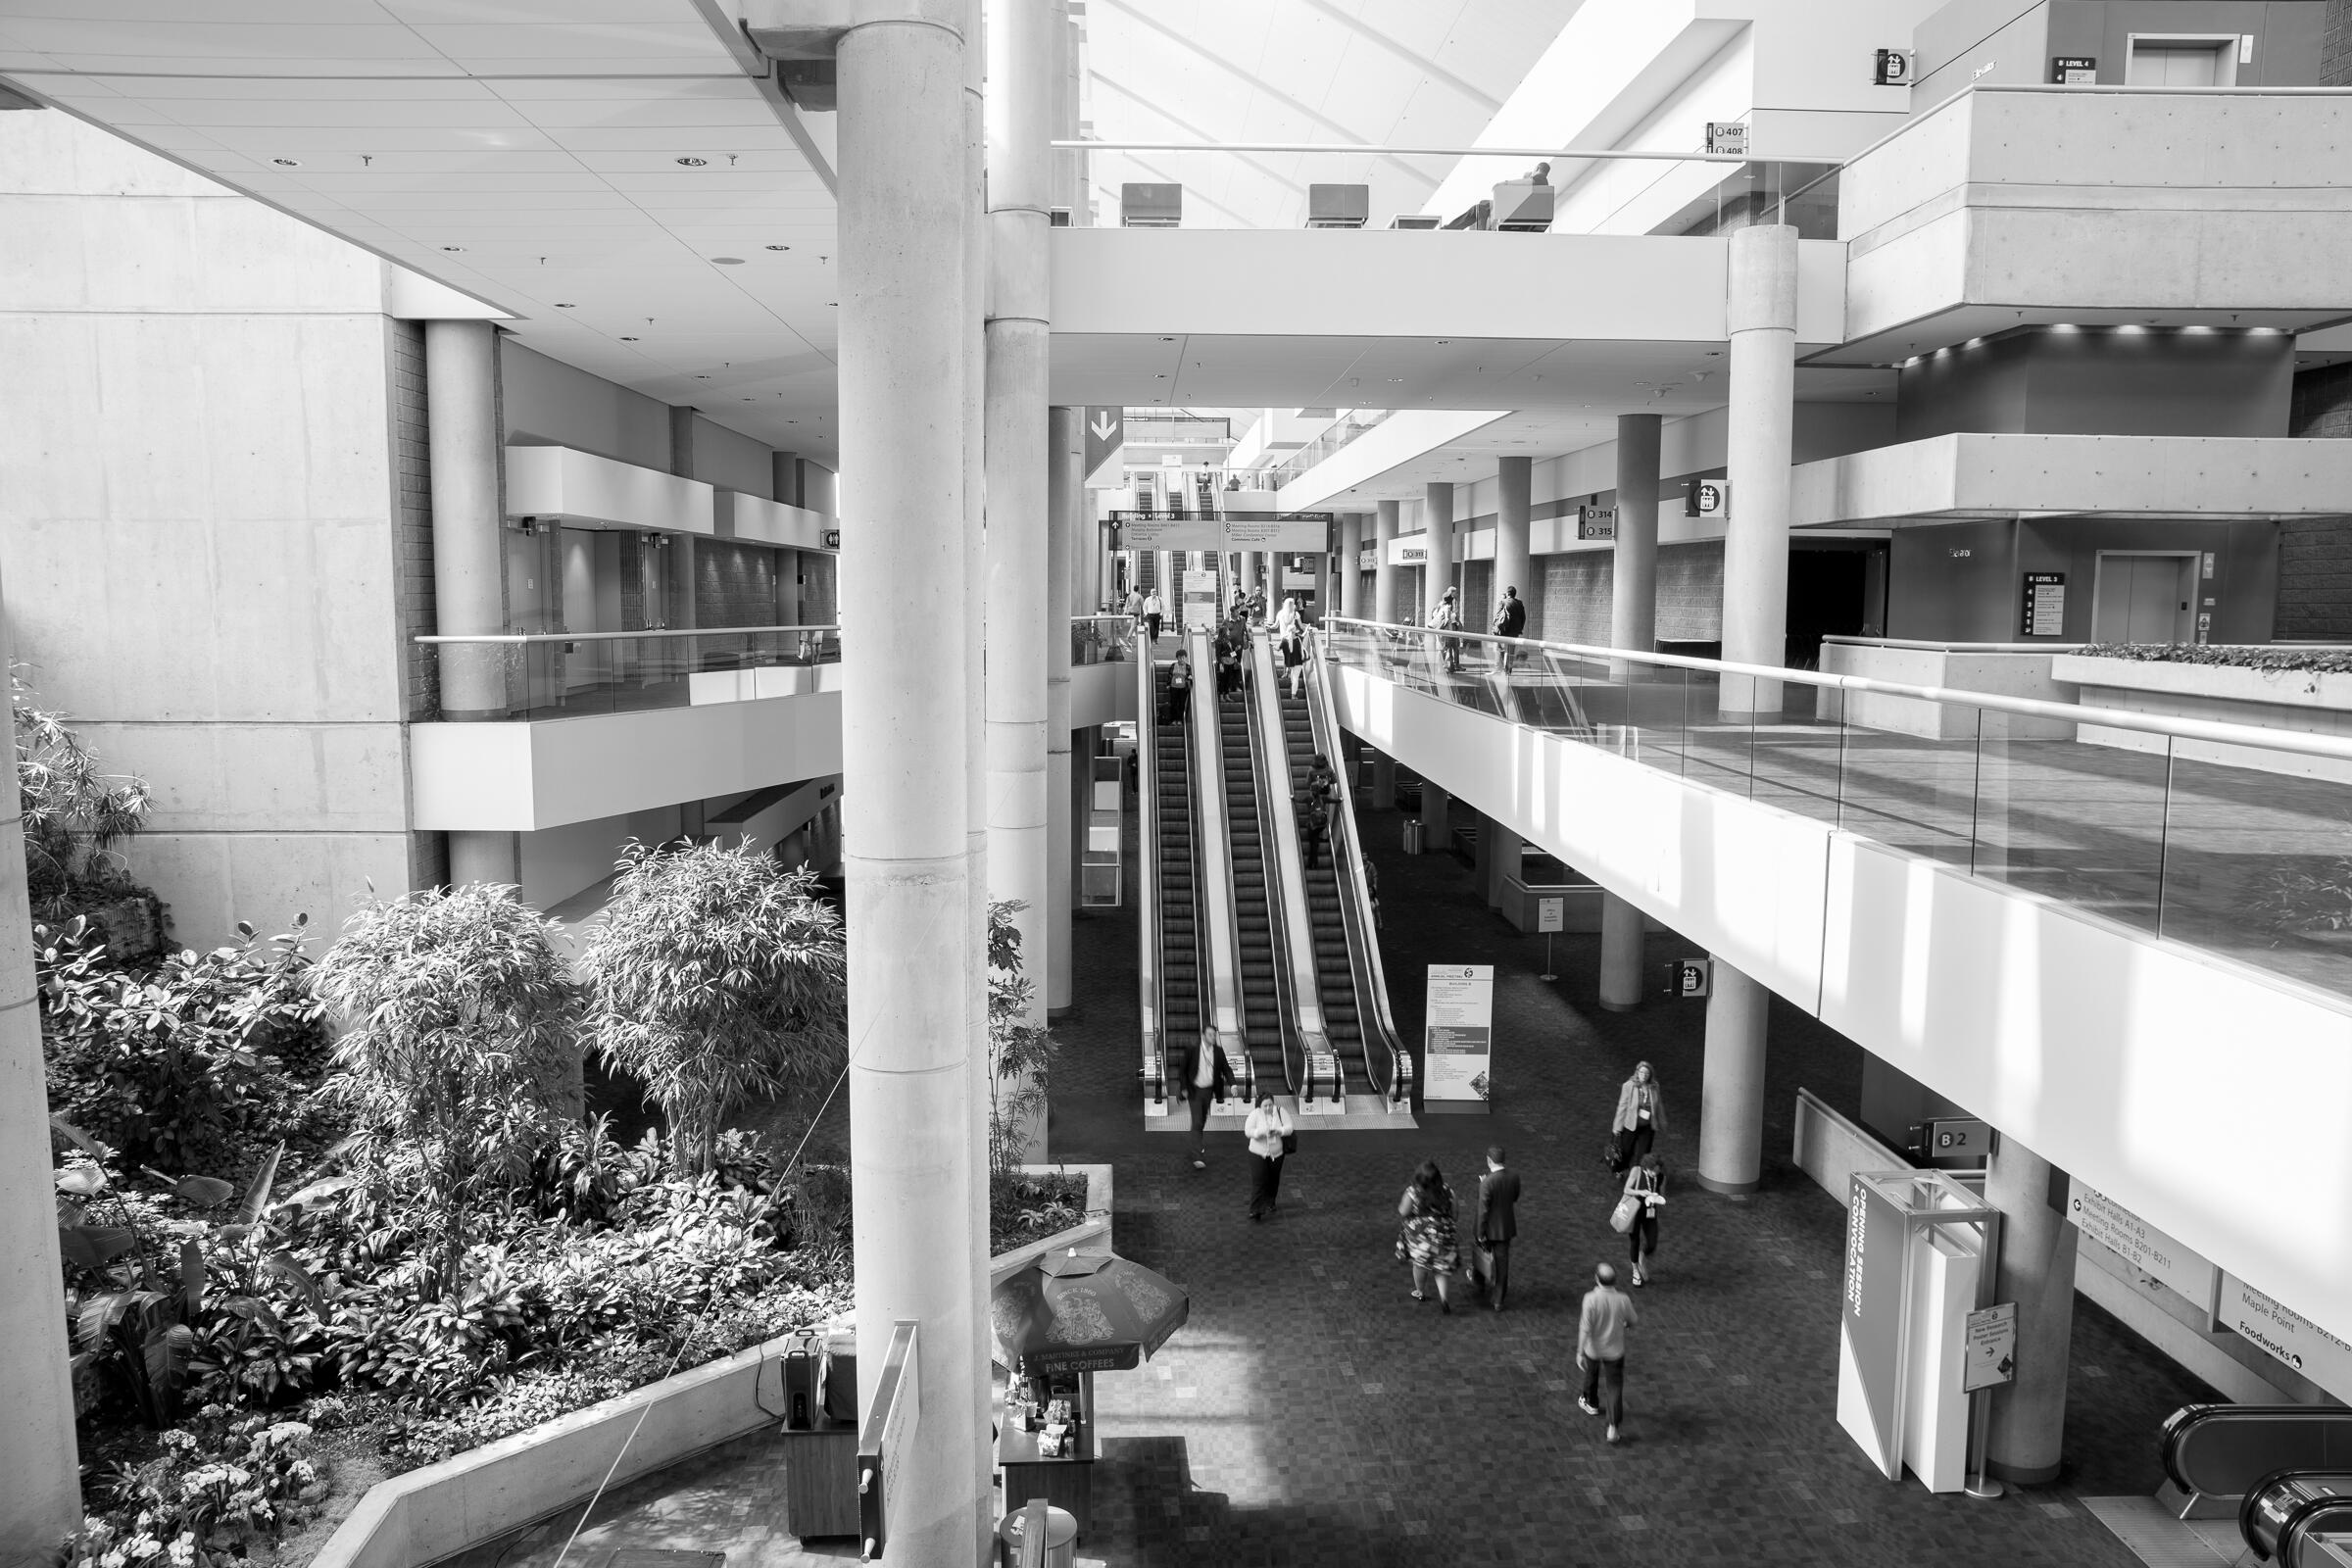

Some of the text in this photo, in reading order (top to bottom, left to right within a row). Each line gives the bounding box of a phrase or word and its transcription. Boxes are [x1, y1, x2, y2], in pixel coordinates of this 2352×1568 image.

[1957, 1133, 1966, 1145] 2
[2084, 1193, 2145, 1239] Exhibit Halls A1-A3
[1848, 1196, 1859, 1302] CONVOCATION
[1854, 1188, 1866, 1317] OPENING SESSION
[2082, 1217, 2142, 1264] Exhibit Halls B1-B2
[2084, 1206, 2171, 1269] Meeting Rooms B201-B211
[1057, 1287, 1078, 1300] SINCE
[2242, 1293, 2295, 1333] Maple Point
[1980, 1337, 2001, 1345] Entrance
[1986, 1321, 2008, 1330] Research
[1989, 1328, 2008, 1337] Sessions
[2240, 1321, 2290, 1361] Foodworks
[1046, 1359, 1114, 1372] FINE COFFEES
